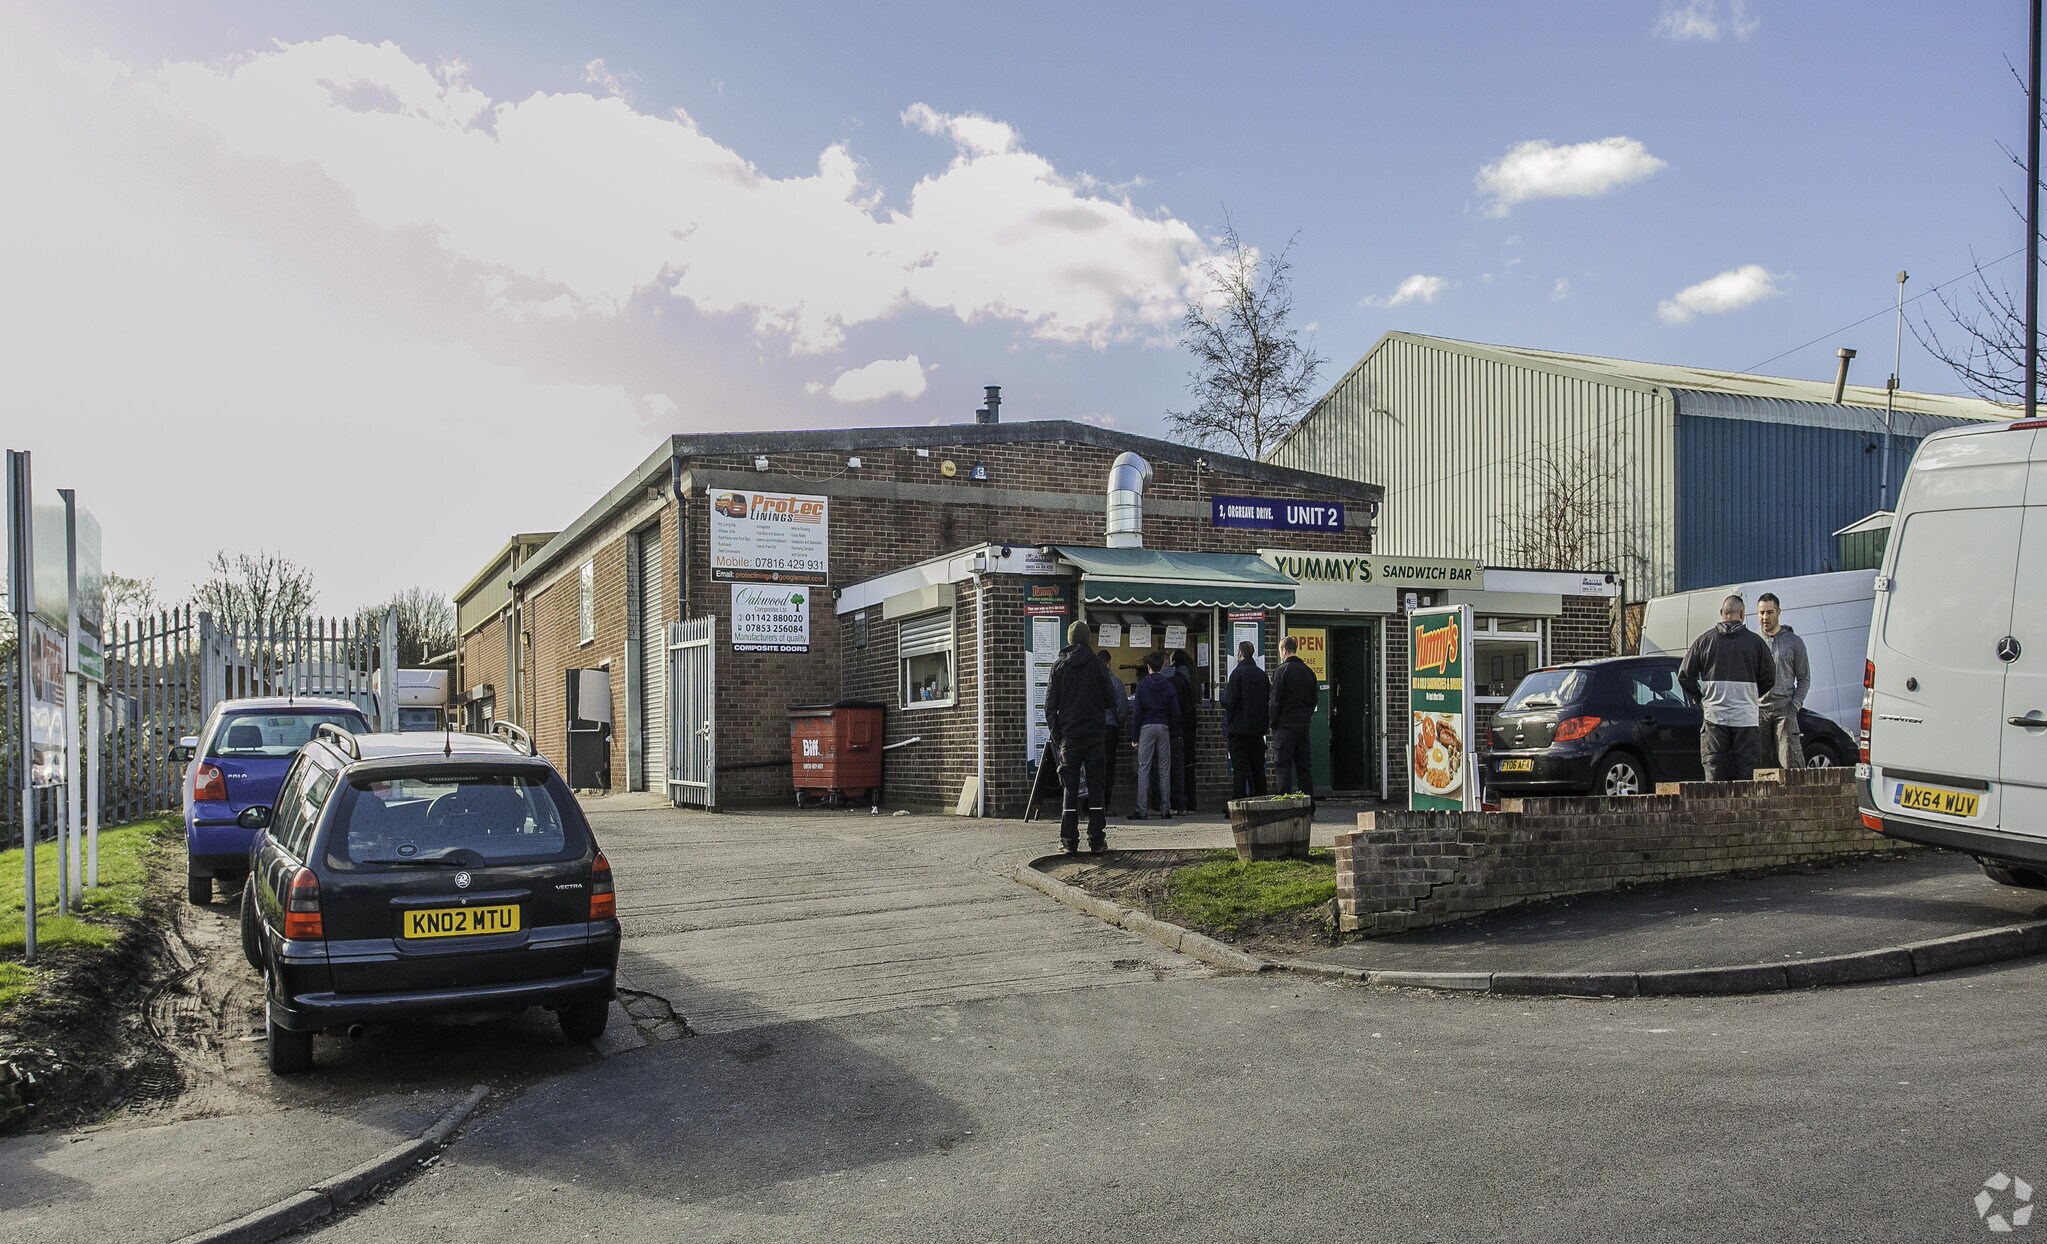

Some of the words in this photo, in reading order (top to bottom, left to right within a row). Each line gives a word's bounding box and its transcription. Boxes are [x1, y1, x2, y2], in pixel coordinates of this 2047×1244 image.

[752, 495, 824, 515] Protec
[1219, 504, 1226, 519] 2,
[1228, 505, 1254, 519] ORGREAVE
[1287, 506, 1324, 525] UNIT
[1328, 508, 1338, 526] 2
[716, 556, 752, 567] Mobile:
[755, 558, 784, 568] 07816
[787, 560, 804, 569] 429
[808, 560, 824, 570] 931
[1275, 555, 1372, 583] YUMMY'S
[1383, 565, 1446, 580] SANDWICH
[1450, 568, 1472, 581] BAR
[736, 587, 791, 606] Oakwood
[735, 633, 777, 641] Manufacturers
[787, 634, 806, 643] quality
[1415, 616, 1458, 674] Yummy's
[1878, 714, 1923, 724] SPRINTER
[1904, 788, 1940, 808] WX64
[1946, 794, 1975, 814] WUV
[413, 912, 467, 934] KN02
[473, 909, 511, 930] MTU
